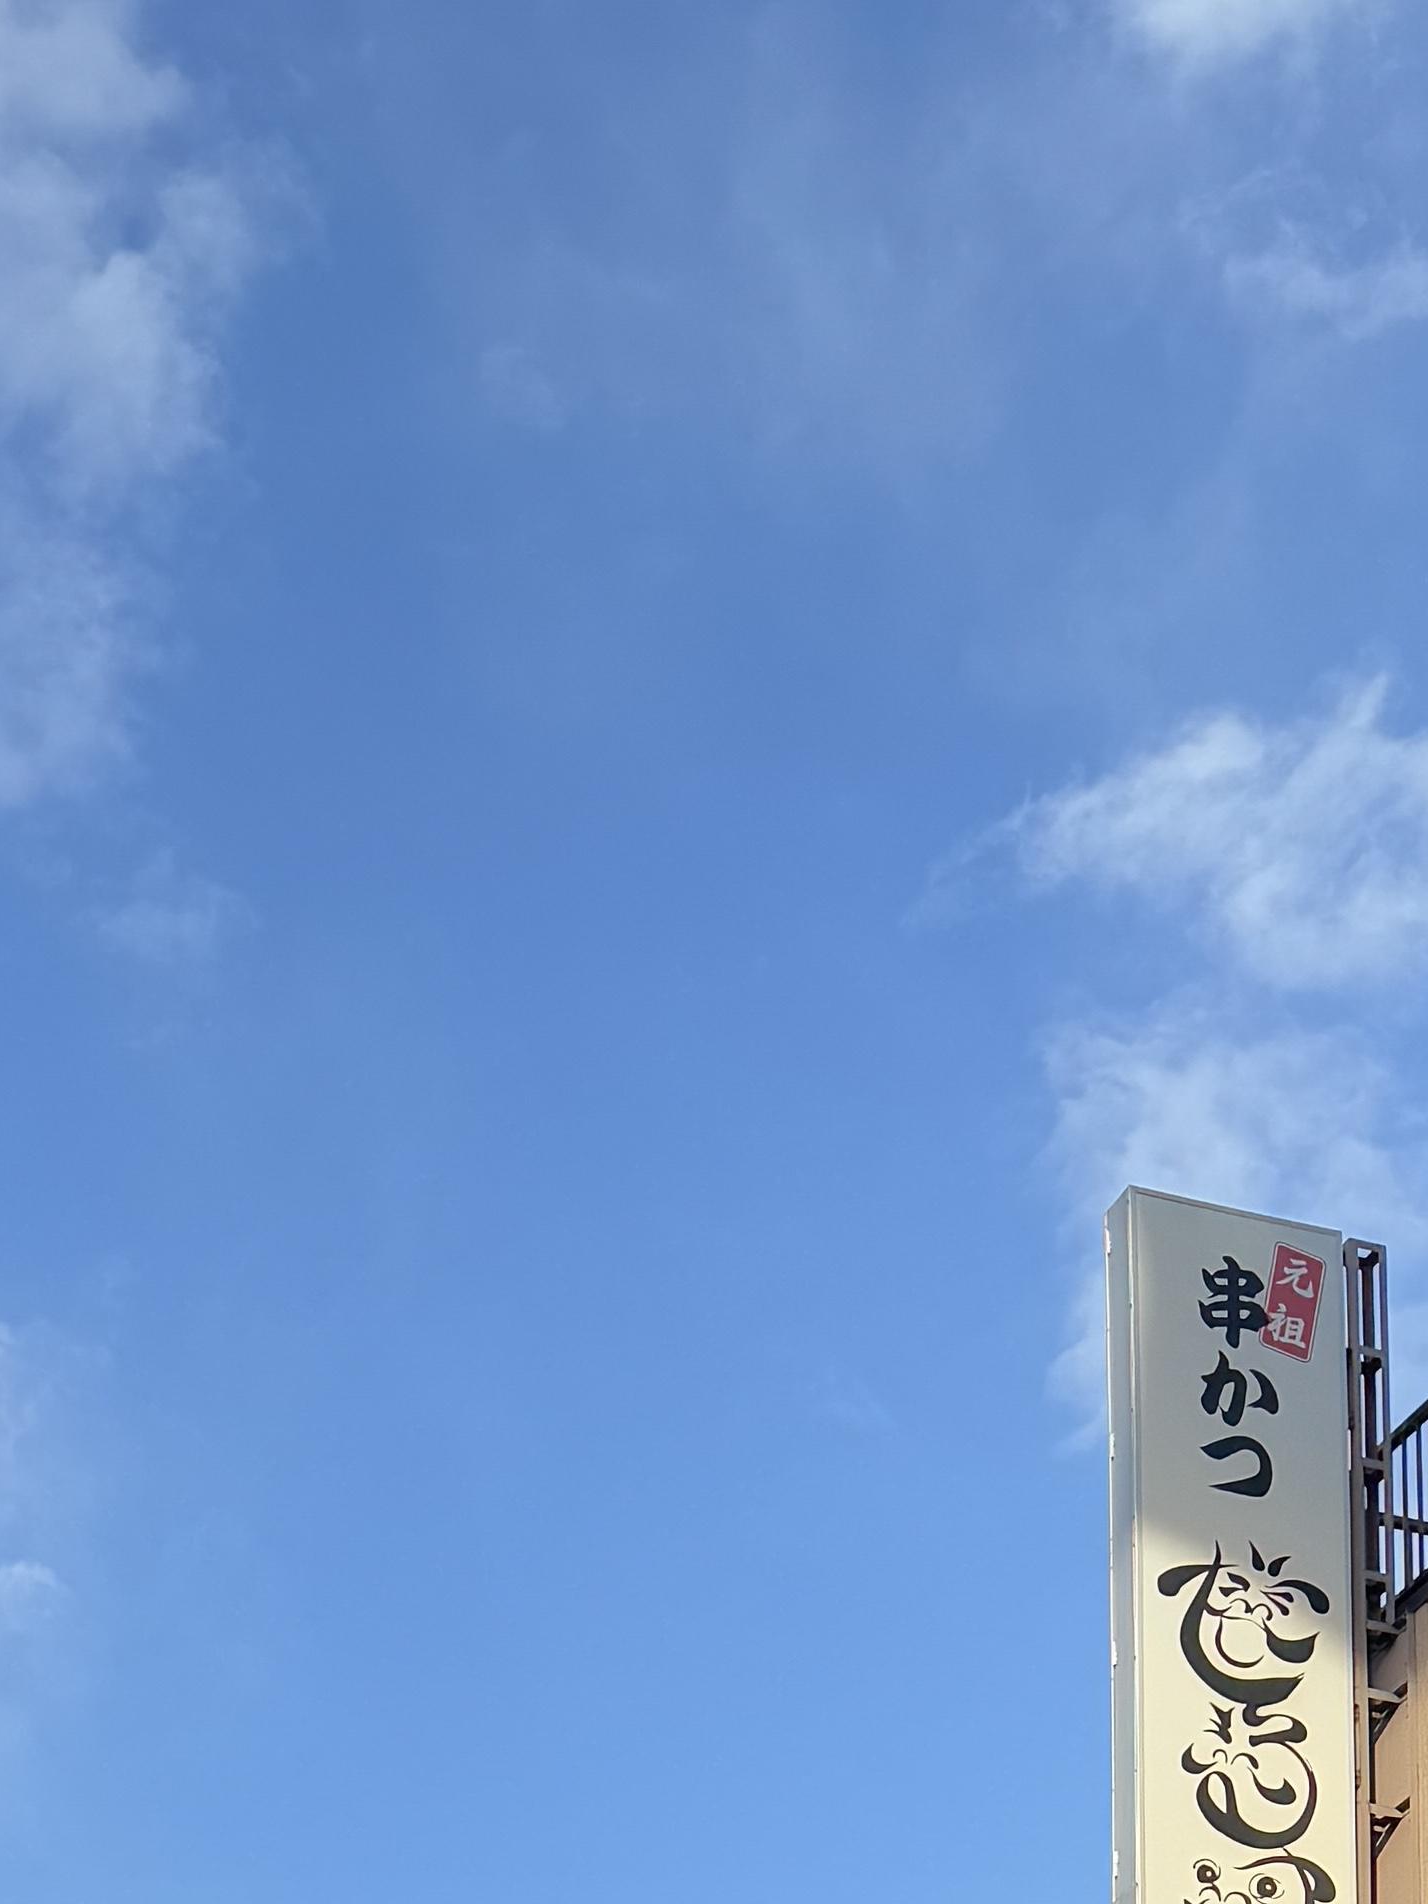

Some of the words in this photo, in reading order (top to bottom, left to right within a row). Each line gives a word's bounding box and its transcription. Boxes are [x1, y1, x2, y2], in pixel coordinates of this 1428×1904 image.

[1197, 1255, 1280, 1498] 串かつ
[1269, 1257, 1315, 1349] 元祖
